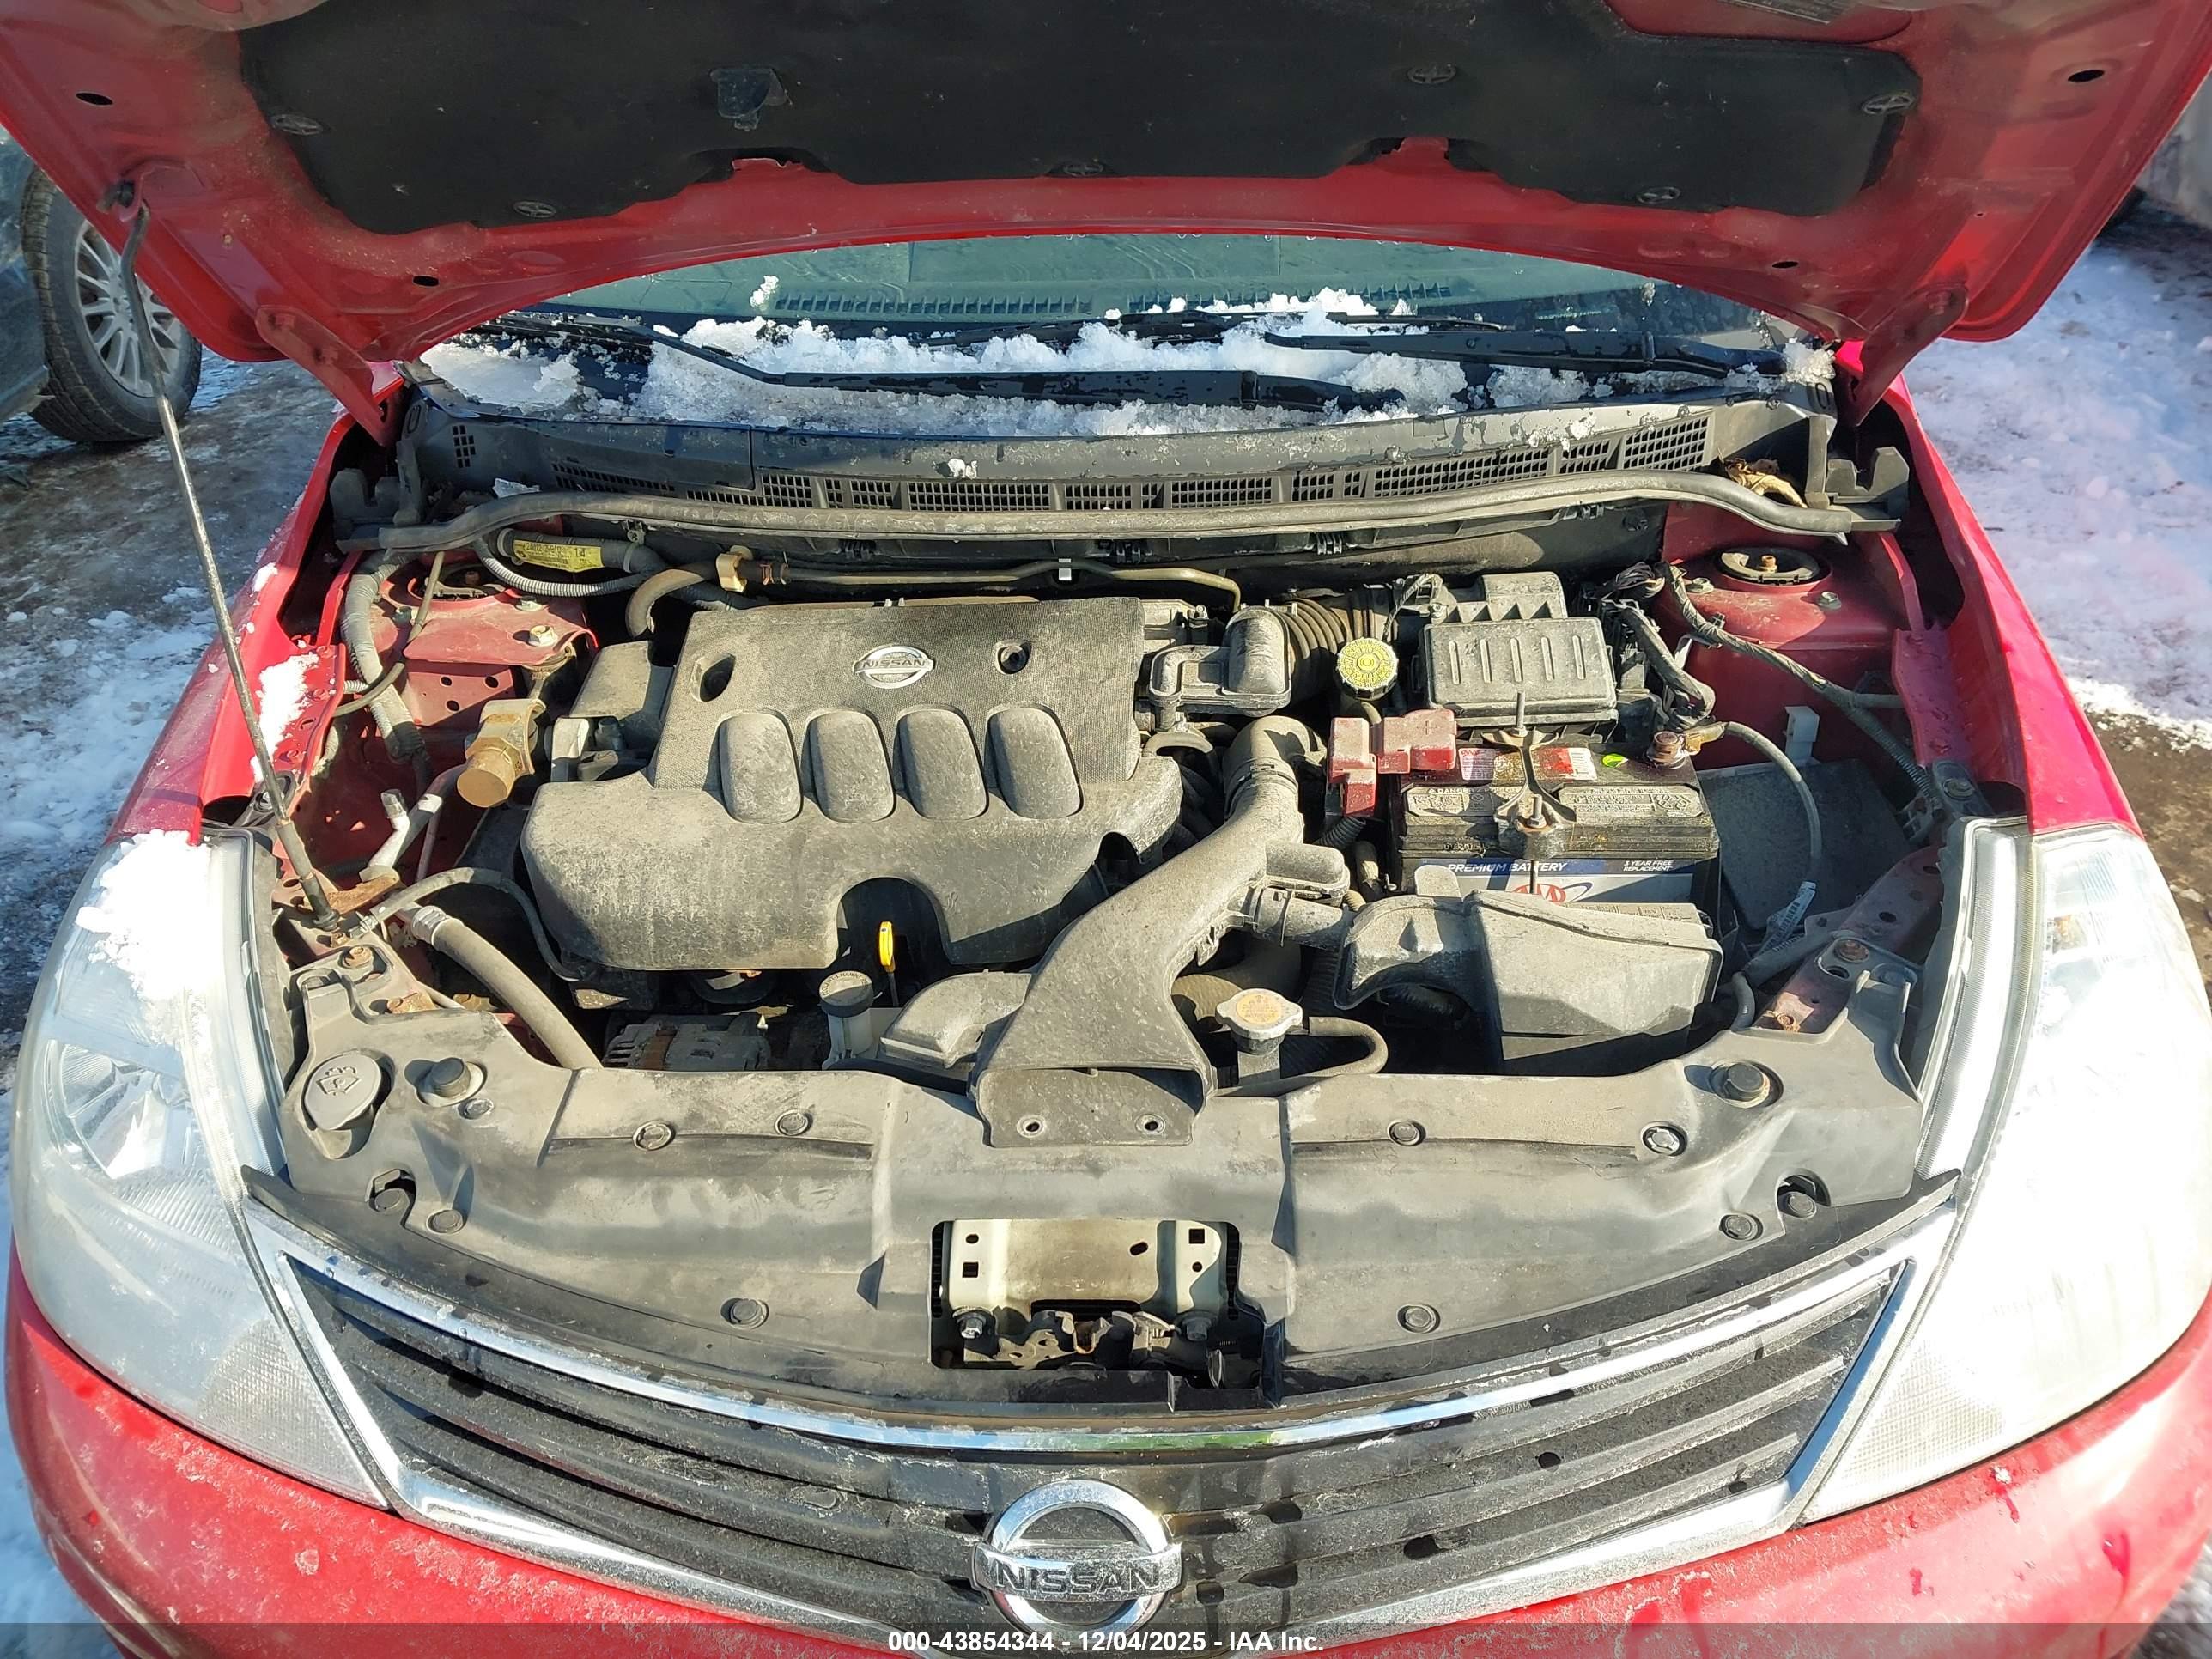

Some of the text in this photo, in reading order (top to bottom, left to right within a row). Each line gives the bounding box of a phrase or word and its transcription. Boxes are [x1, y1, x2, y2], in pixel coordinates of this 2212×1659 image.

[863, 659, 926, 668] NISSAN
[1448, 863, 1507, 872] PREMIUM
[994, 1559, 1161, 1595] NISSAN
